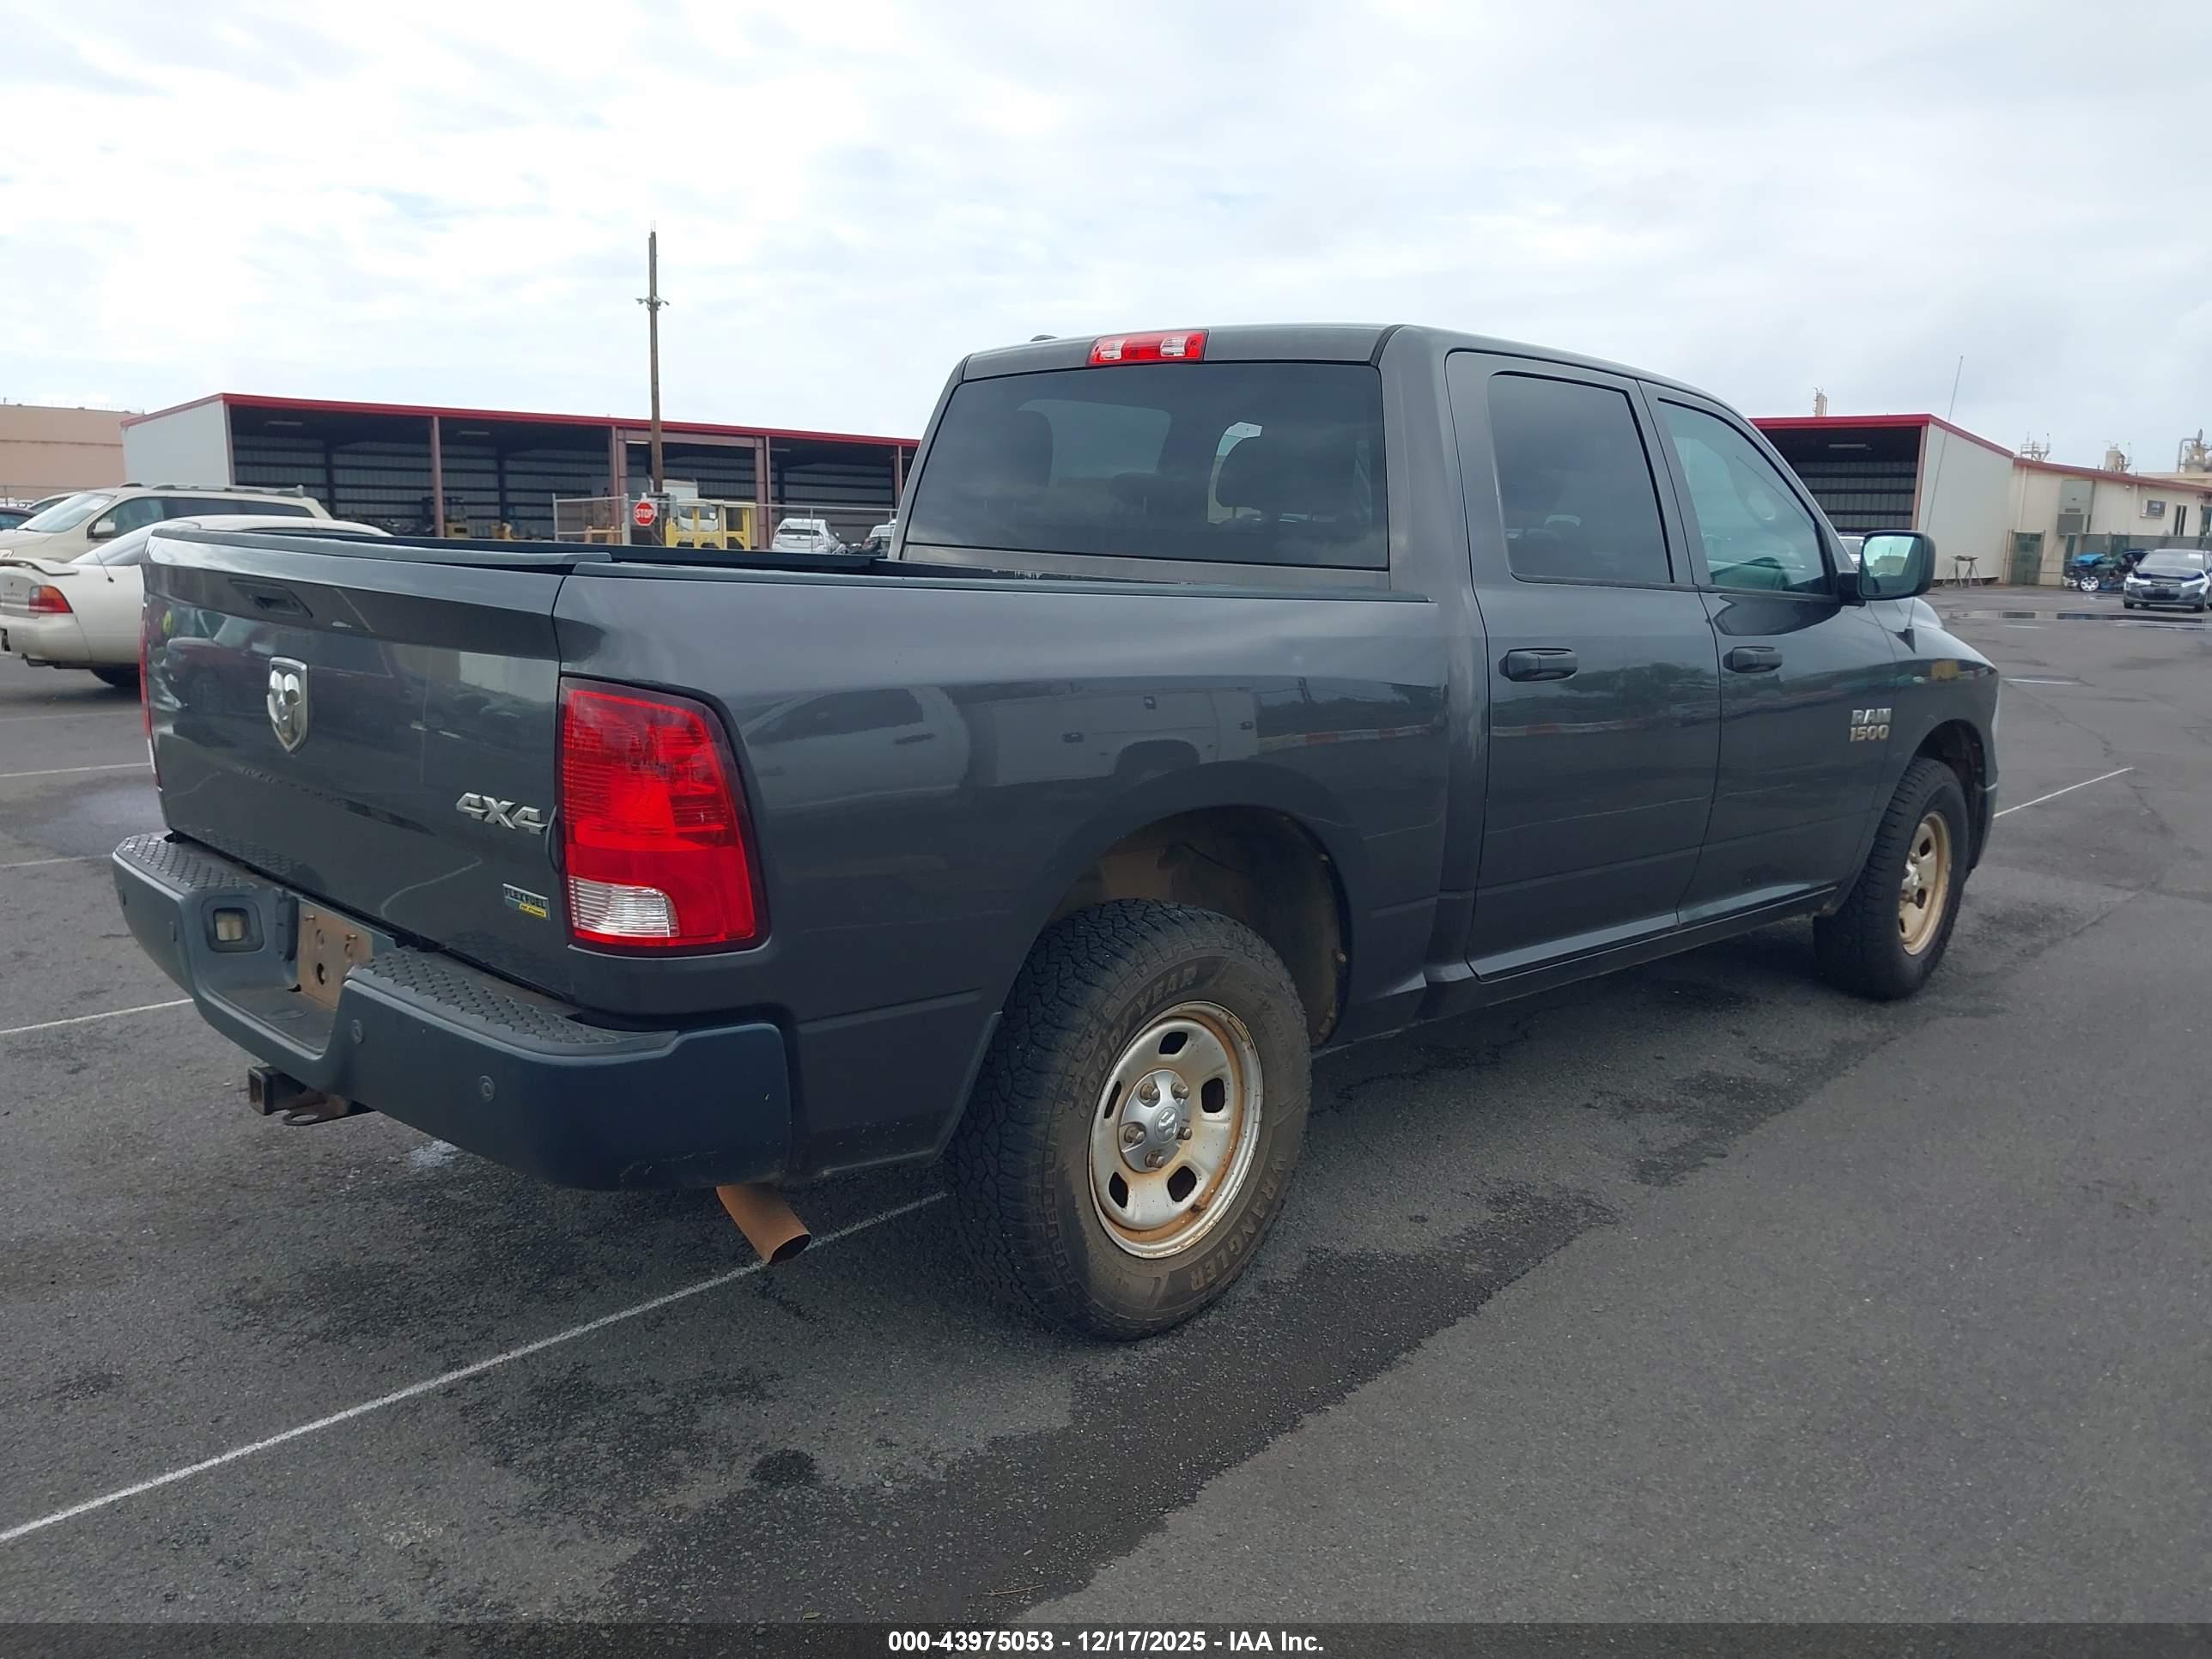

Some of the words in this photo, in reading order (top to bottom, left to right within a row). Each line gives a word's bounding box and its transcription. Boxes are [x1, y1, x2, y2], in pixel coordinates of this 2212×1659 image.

[635, 507, 653, 519] STOP
[1850, 708, 1892, 725] RAM
[1850, 725, 1889, 742] 1500
[1190, 1151, 1289, 1291] WRANGLER
